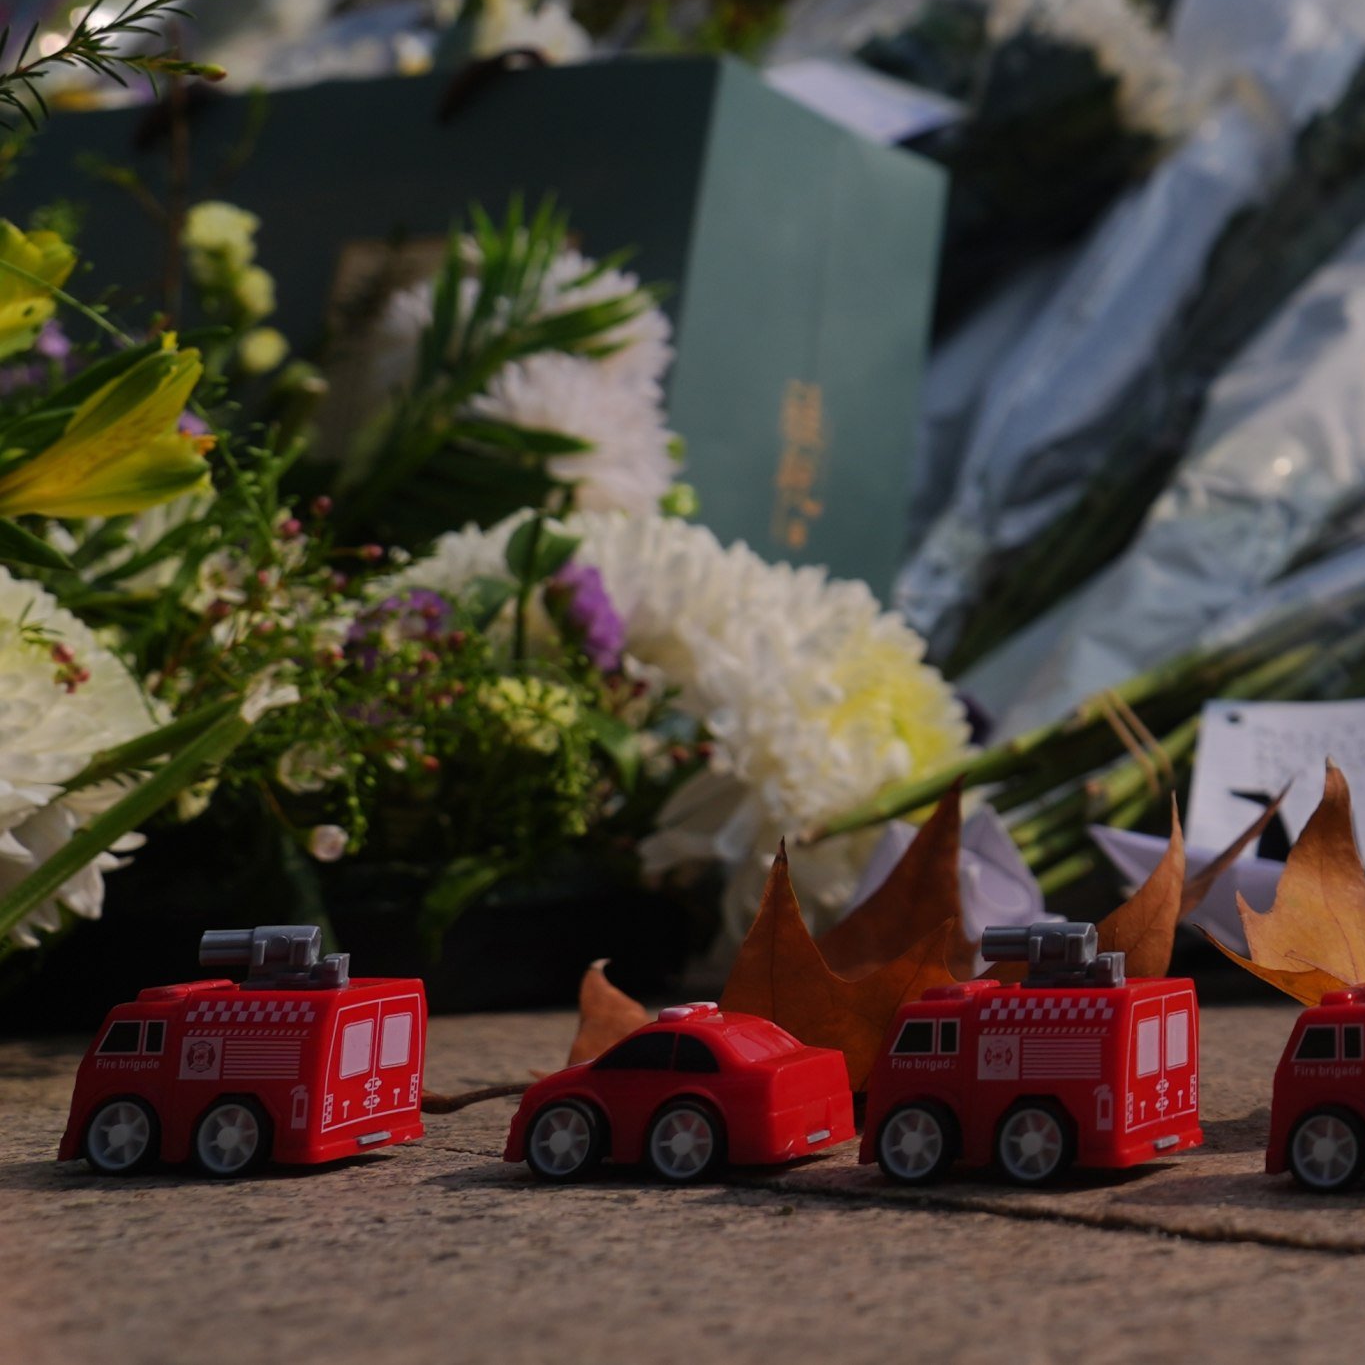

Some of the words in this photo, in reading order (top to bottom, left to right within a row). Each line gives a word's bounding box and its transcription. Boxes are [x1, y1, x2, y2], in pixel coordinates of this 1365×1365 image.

[96, 1058, 118, 1070] Fire
[119, 1058, 160, 1072] brigade
[891, 1058, 913, 1069] Fire
[1294, 1065, 1316, 1077] Fire
[1318, 1064, 1362, 1080] brigade
